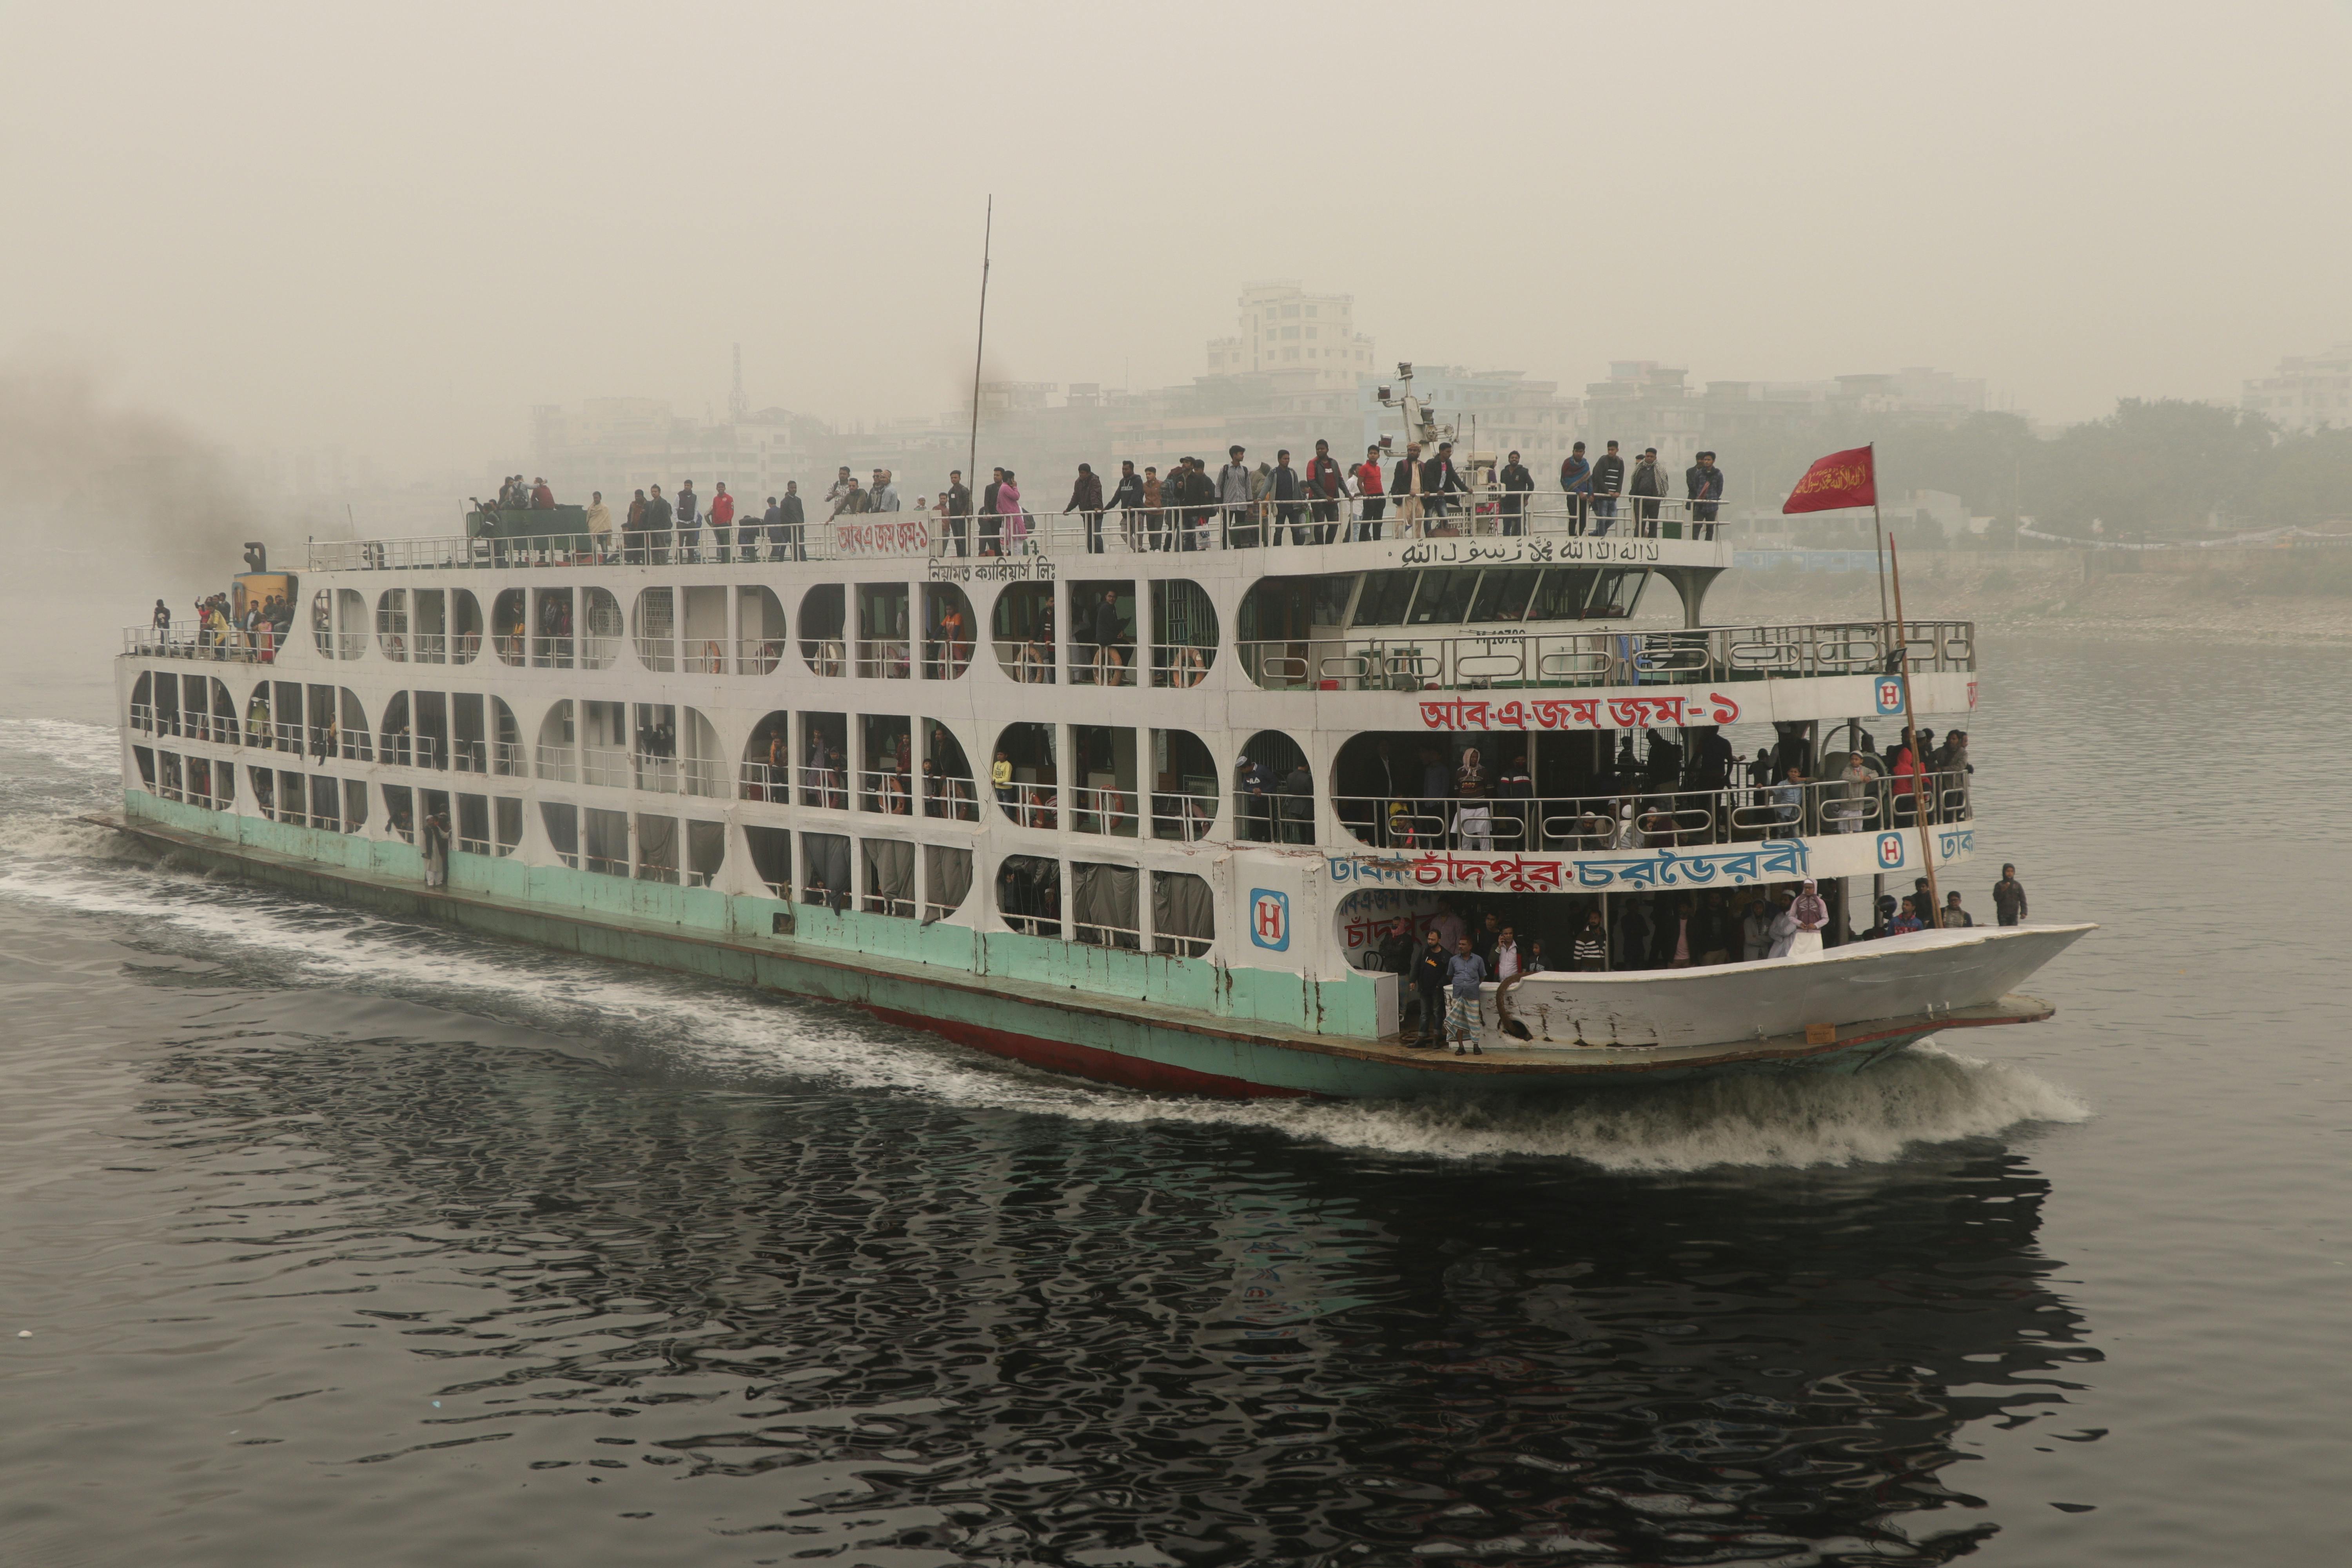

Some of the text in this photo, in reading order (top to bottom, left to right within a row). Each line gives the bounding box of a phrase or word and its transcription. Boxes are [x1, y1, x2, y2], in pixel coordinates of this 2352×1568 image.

[837, 523, 865, 554] আব
[928, 557, 971, 581] নিয়ামত
[1882, 686, 1898, 705] H
[1884, 840, 1898, 860] H
[1412, 851, 1563, 893] চাঁদপুর
[1573, 838, 1810, 889] চরভৈরবী
[1258, 901, 1281, 939] H
